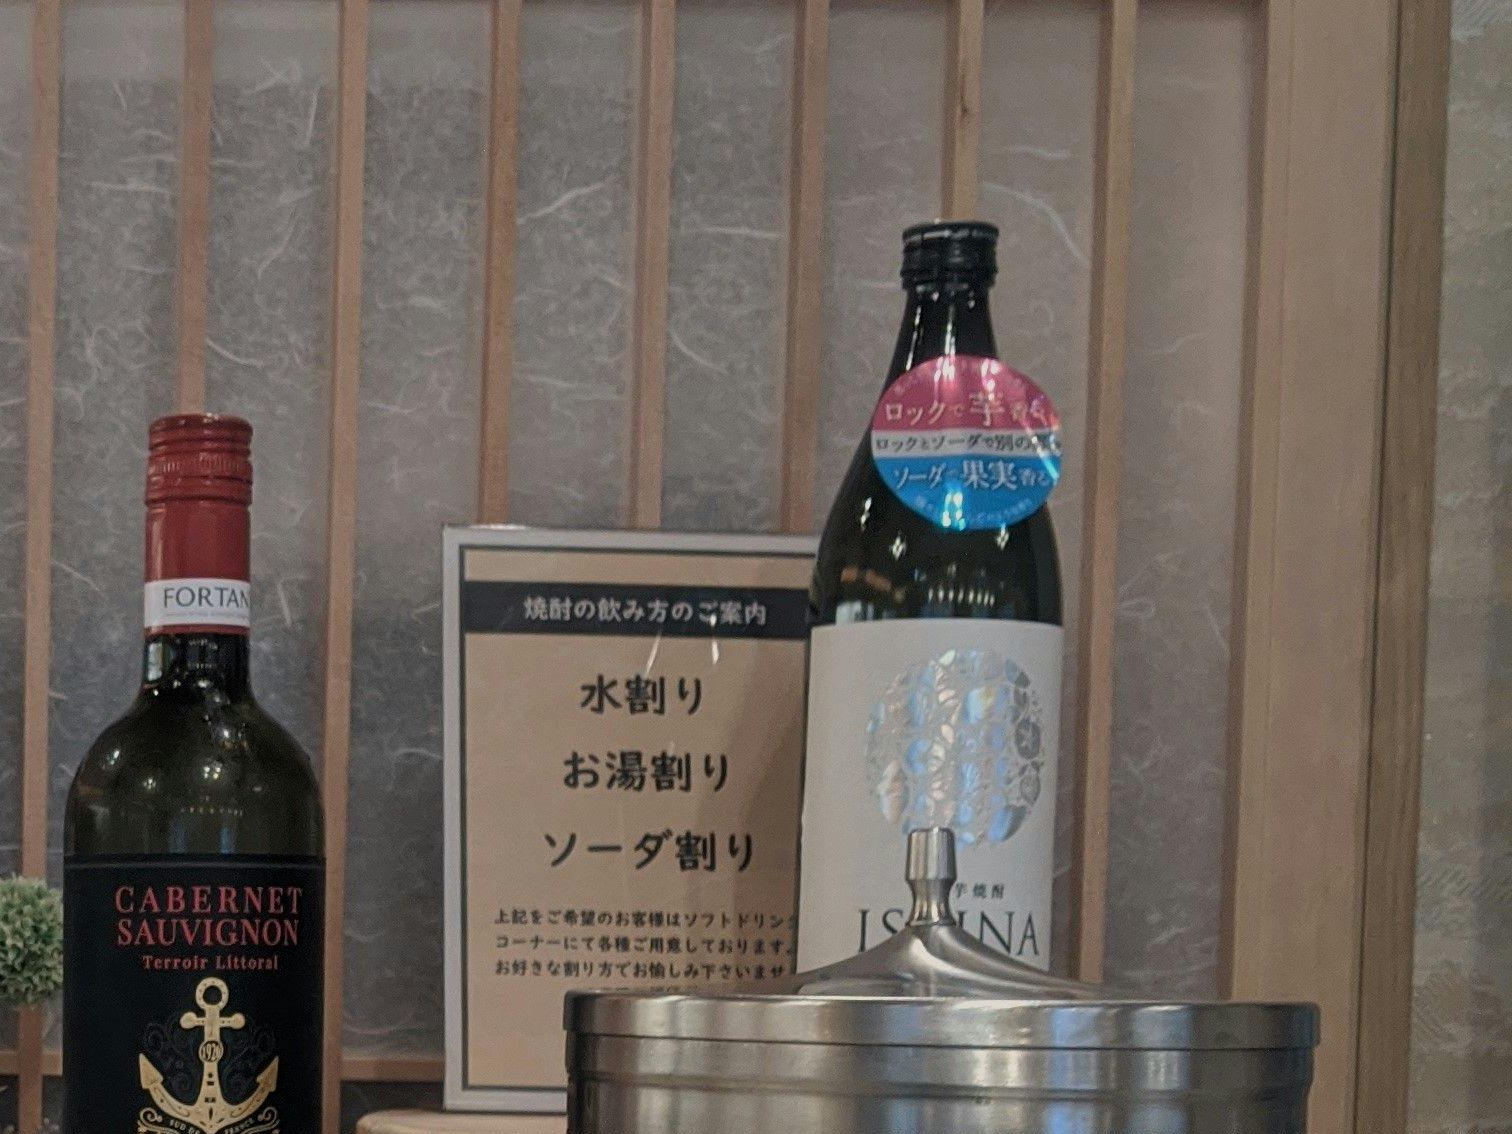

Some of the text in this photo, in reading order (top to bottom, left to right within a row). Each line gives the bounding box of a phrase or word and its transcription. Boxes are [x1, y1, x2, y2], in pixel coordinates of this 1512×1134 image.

[523, 596, 767, 626] 焼酎の飲み方のご案内
[580, 674, 703, 715] 水割り
[563, 751, 729, 793] お湯割り
[545, 829, 753, 872] ソーダ割り
[114, 885, 302, 915] CABERNET
[117, 918, 299, 947] SAUVIGNON
[142, 955, 278, 971] Terroir Littoral
